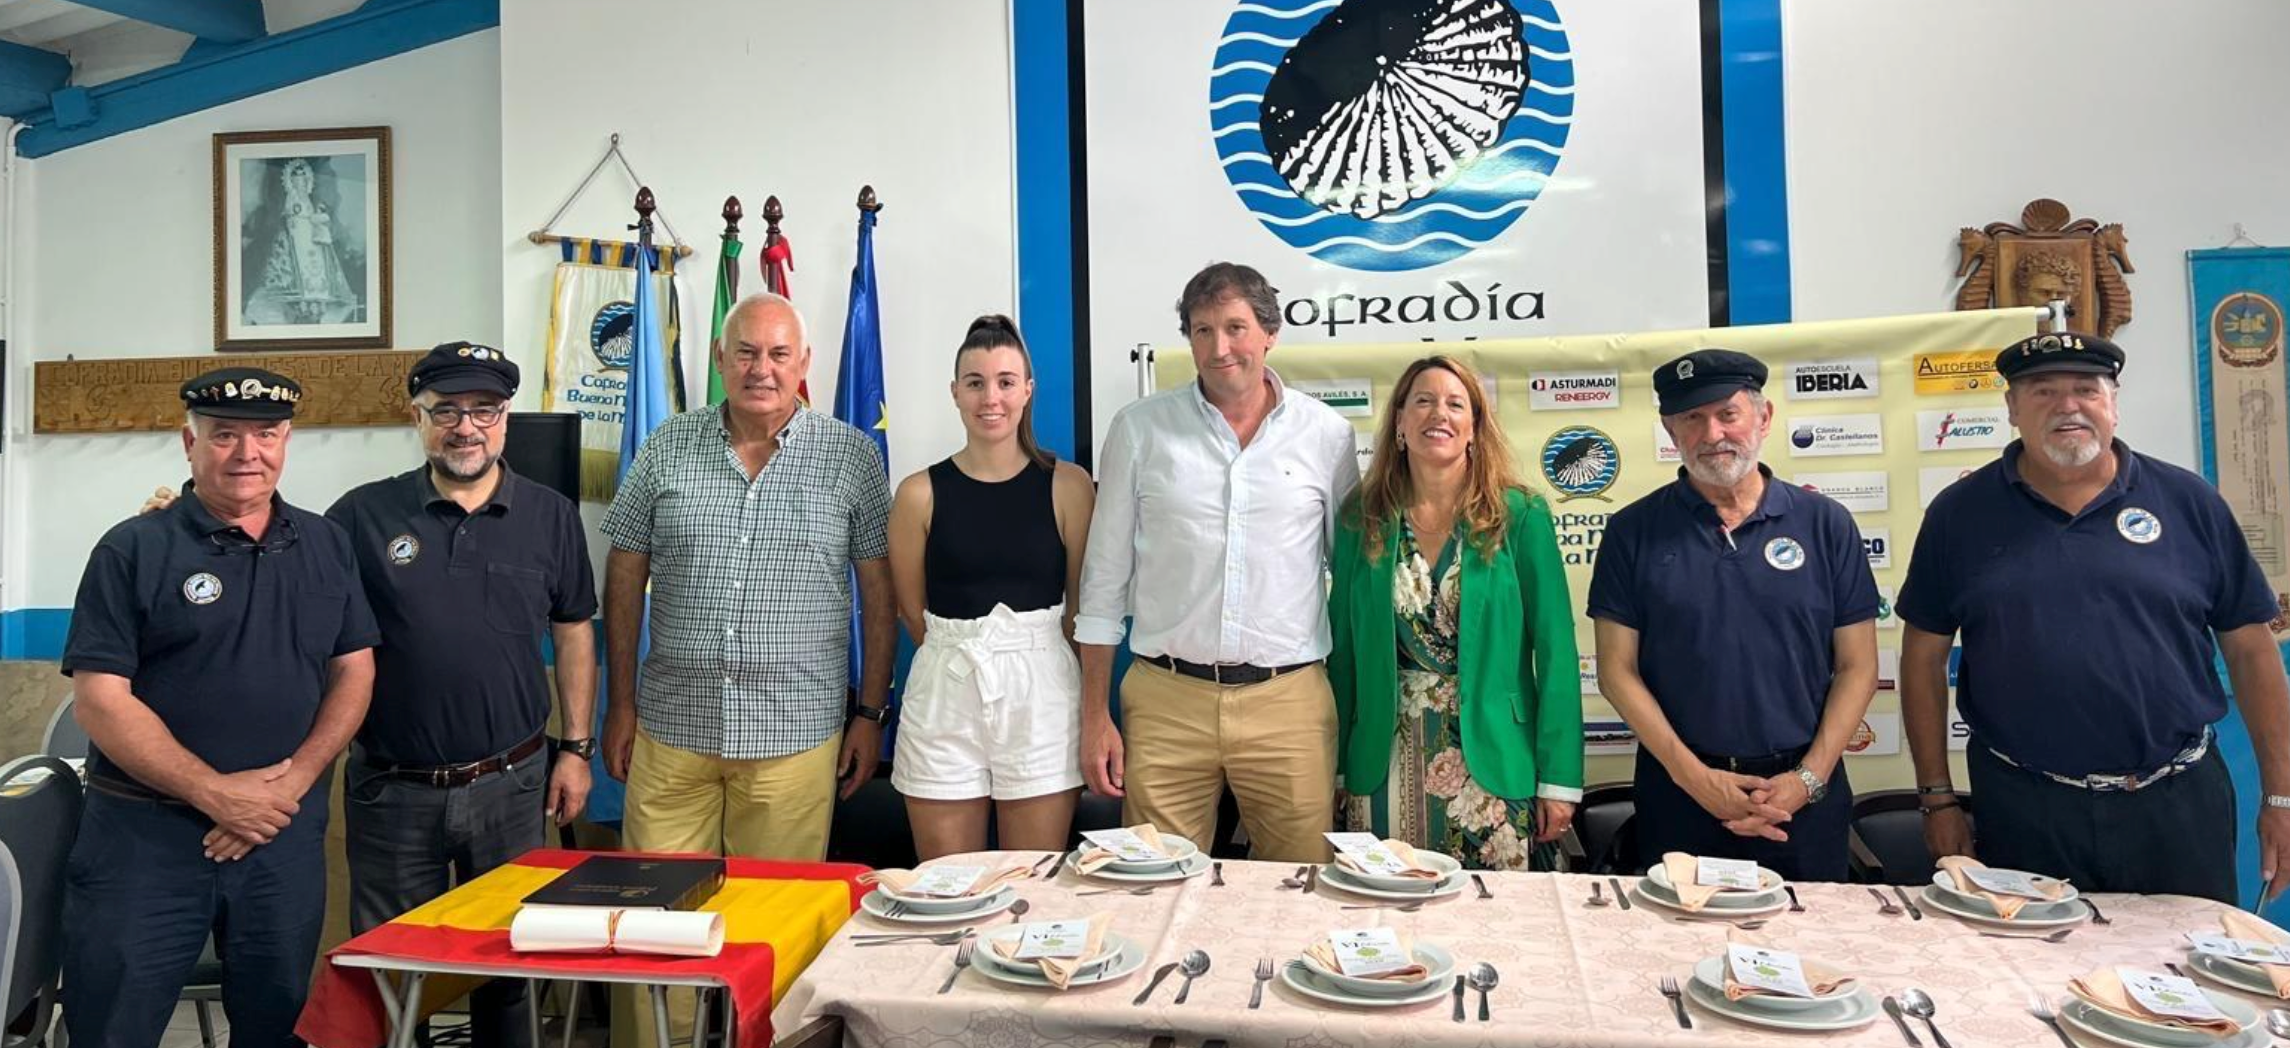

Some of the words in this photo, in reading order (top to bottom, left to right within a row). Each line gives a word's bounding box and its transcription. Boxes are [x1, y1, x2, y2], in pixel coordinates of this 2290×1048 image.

[1283, 280, 1545, 337] ofradía
[1795, 365, 1851, 373] AUTOESCUELA
[1550, 378, 1616, 389] ASTURMADI
[1796, 373, 1868, 392] IBERIA
